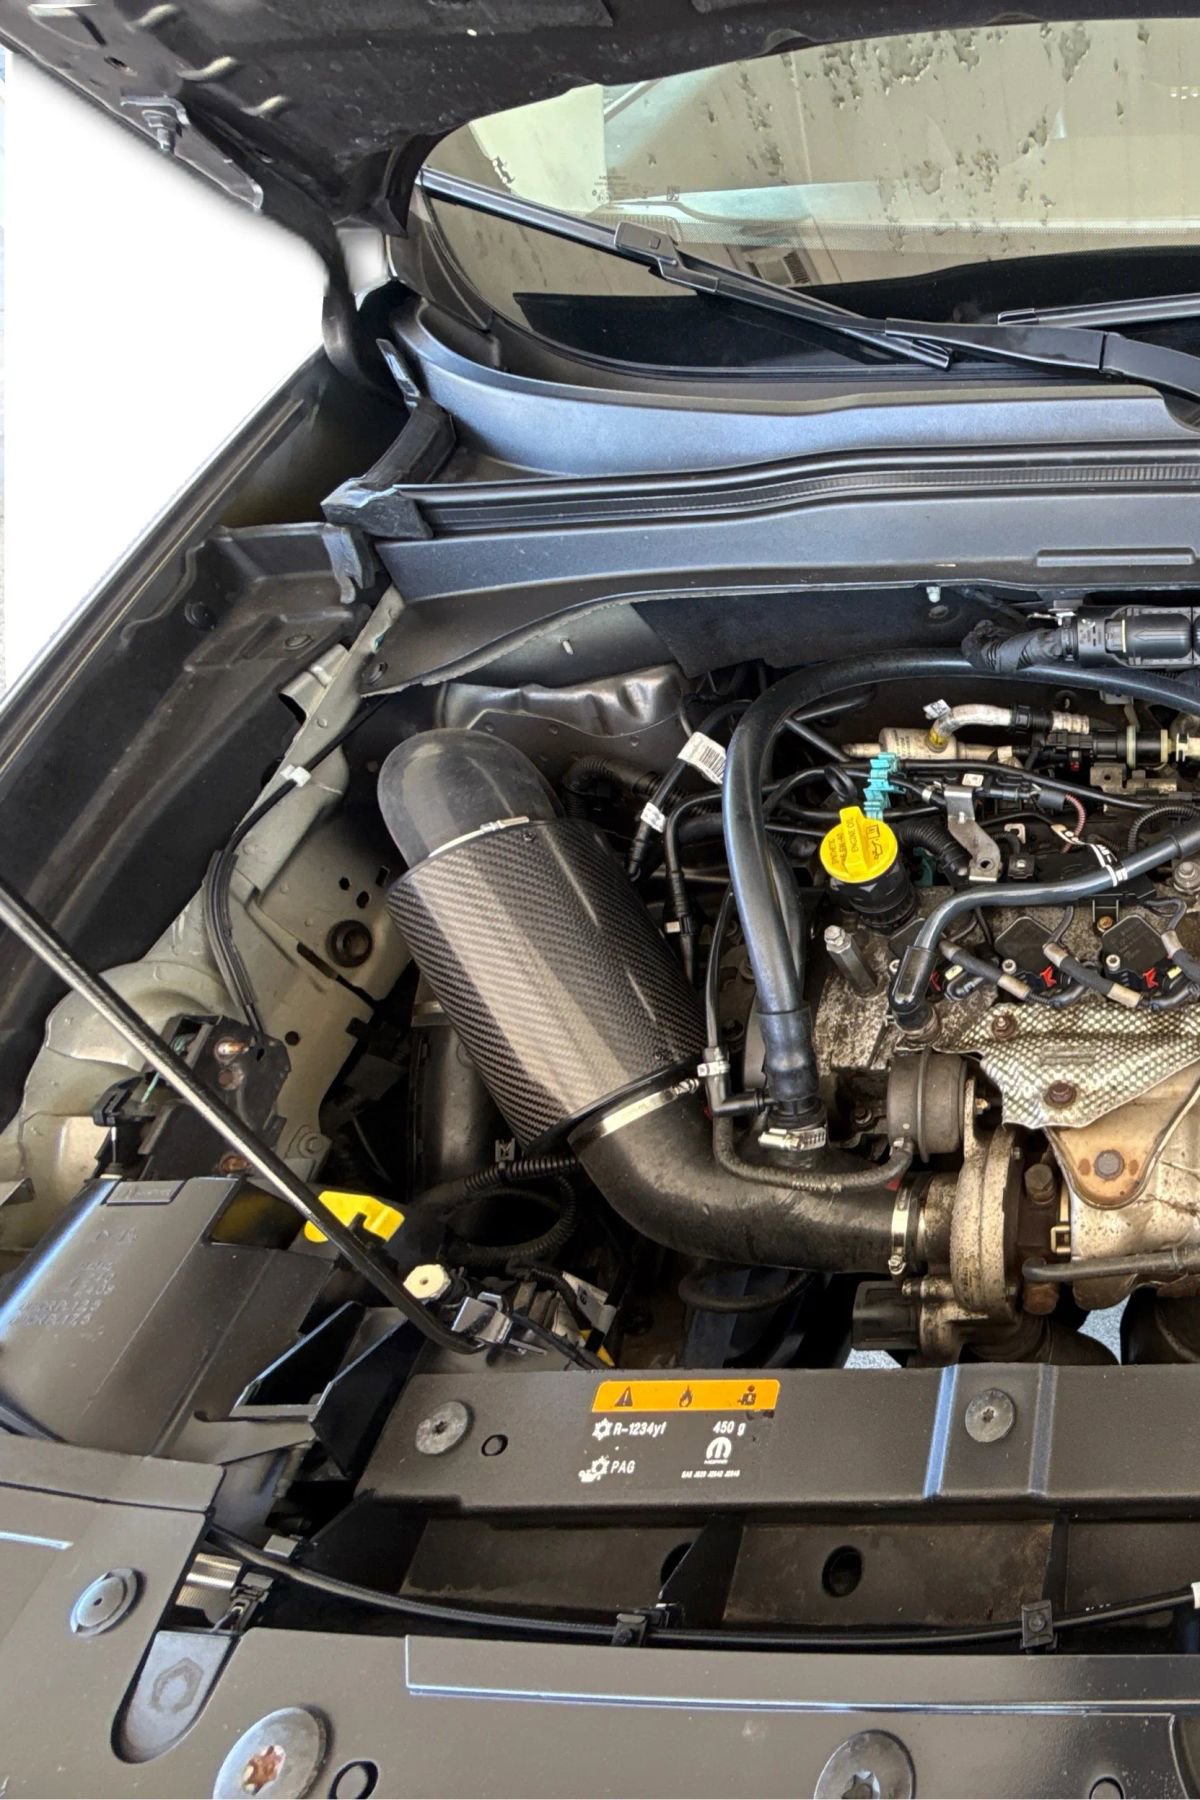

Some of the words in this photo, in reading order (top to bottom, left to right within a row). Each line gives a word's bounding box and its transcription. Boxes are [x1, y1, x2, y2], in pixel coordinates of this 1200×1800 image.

[613, 1421, 667, 1438] R-1234yf
[713, 1421, 734, 1434] 450
[737, 1422, 746, 1436] g
[610, 1460, 636, 1474] PAG
